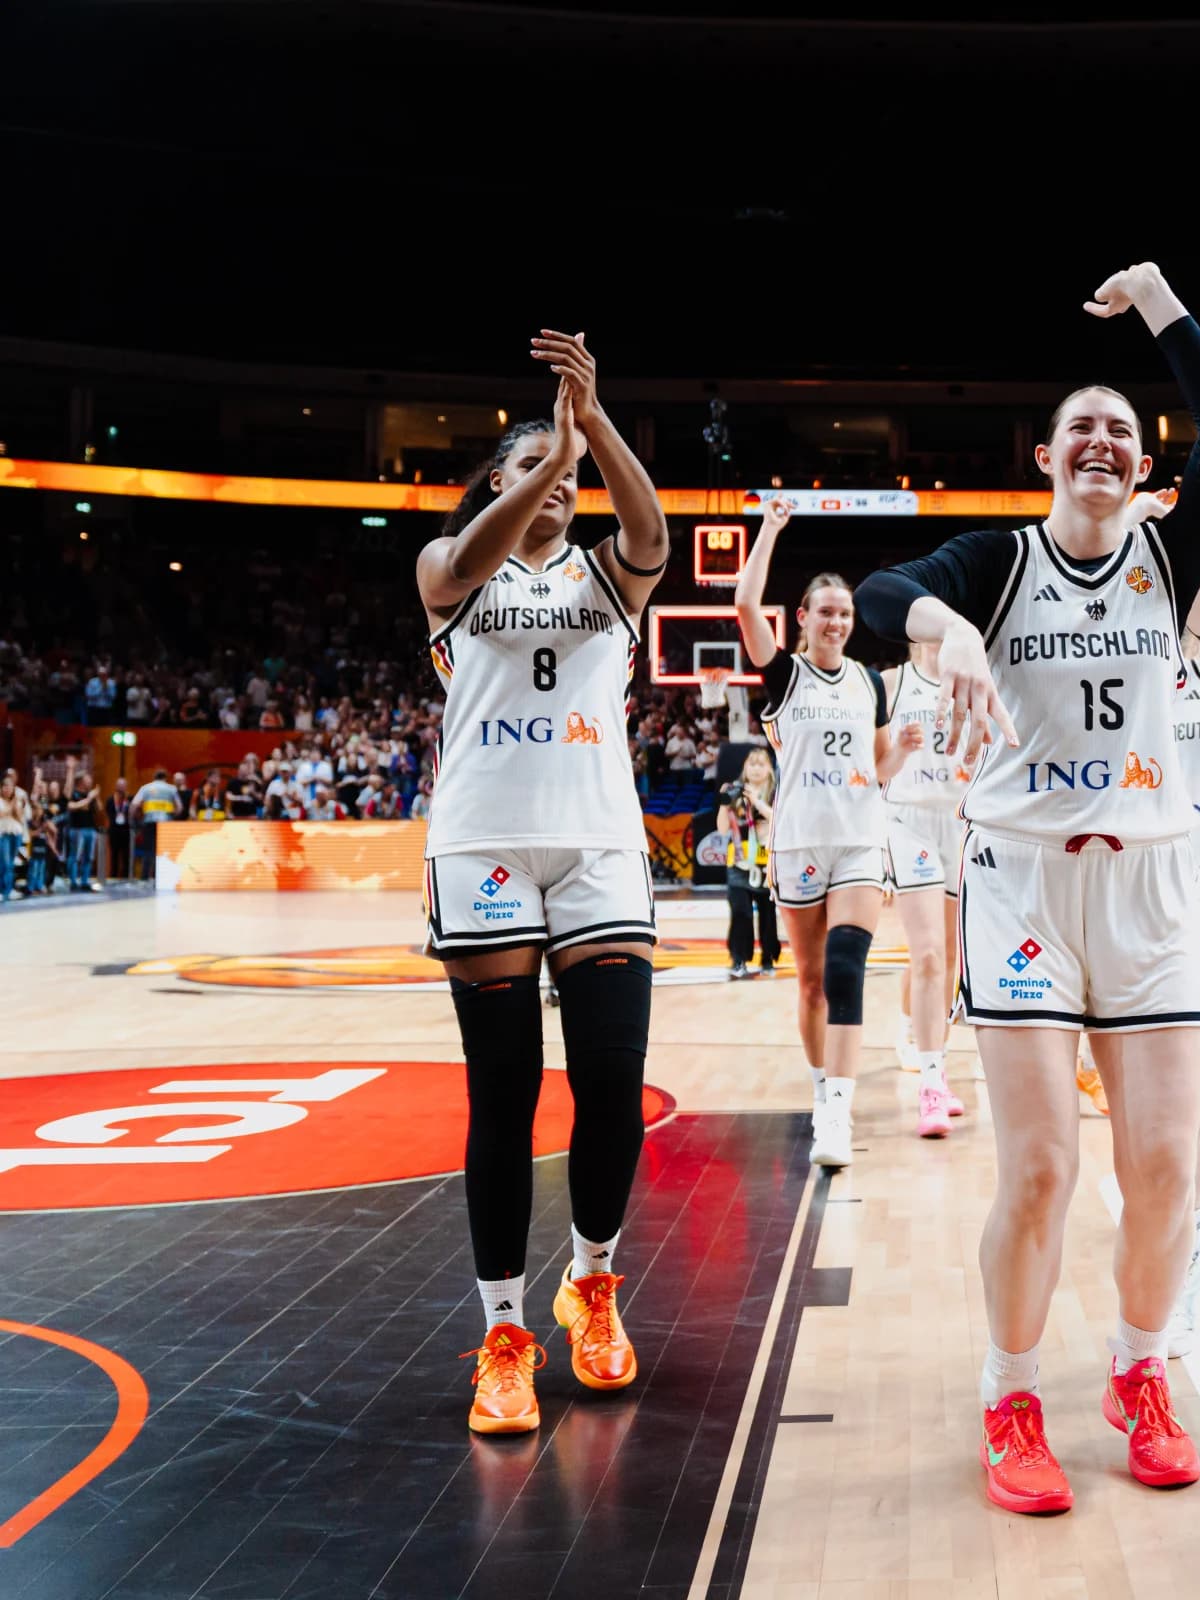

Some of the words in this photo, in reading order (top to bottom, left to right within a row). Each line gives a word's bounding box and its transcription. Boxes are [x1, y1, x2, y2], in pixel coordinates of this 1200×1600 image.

[707, 531, 733, 550] 00
[470, 607, 613, 637] DEUTSCHLAND
[1010, 628, 1170, 666] DEUTSCHLAND
[533, 647, 557, 691] 8
[1080, 678, 1124, 731] 15
[480, 717, 554, 747] ING
[933, 731, 949, 754] 2
[823, 731, 852, 757] 22
[803, 769, 842, 787] ING
[914, 768, 949, 785] ING
[1026, 760, 1112, 793] ING
[473, 899, 522, 911] Domino's
[485, 911, 513, 920] Pizza
[999, 977, 1052, 988] Domino's
[1011, 988, 1043, 999] Pizza
